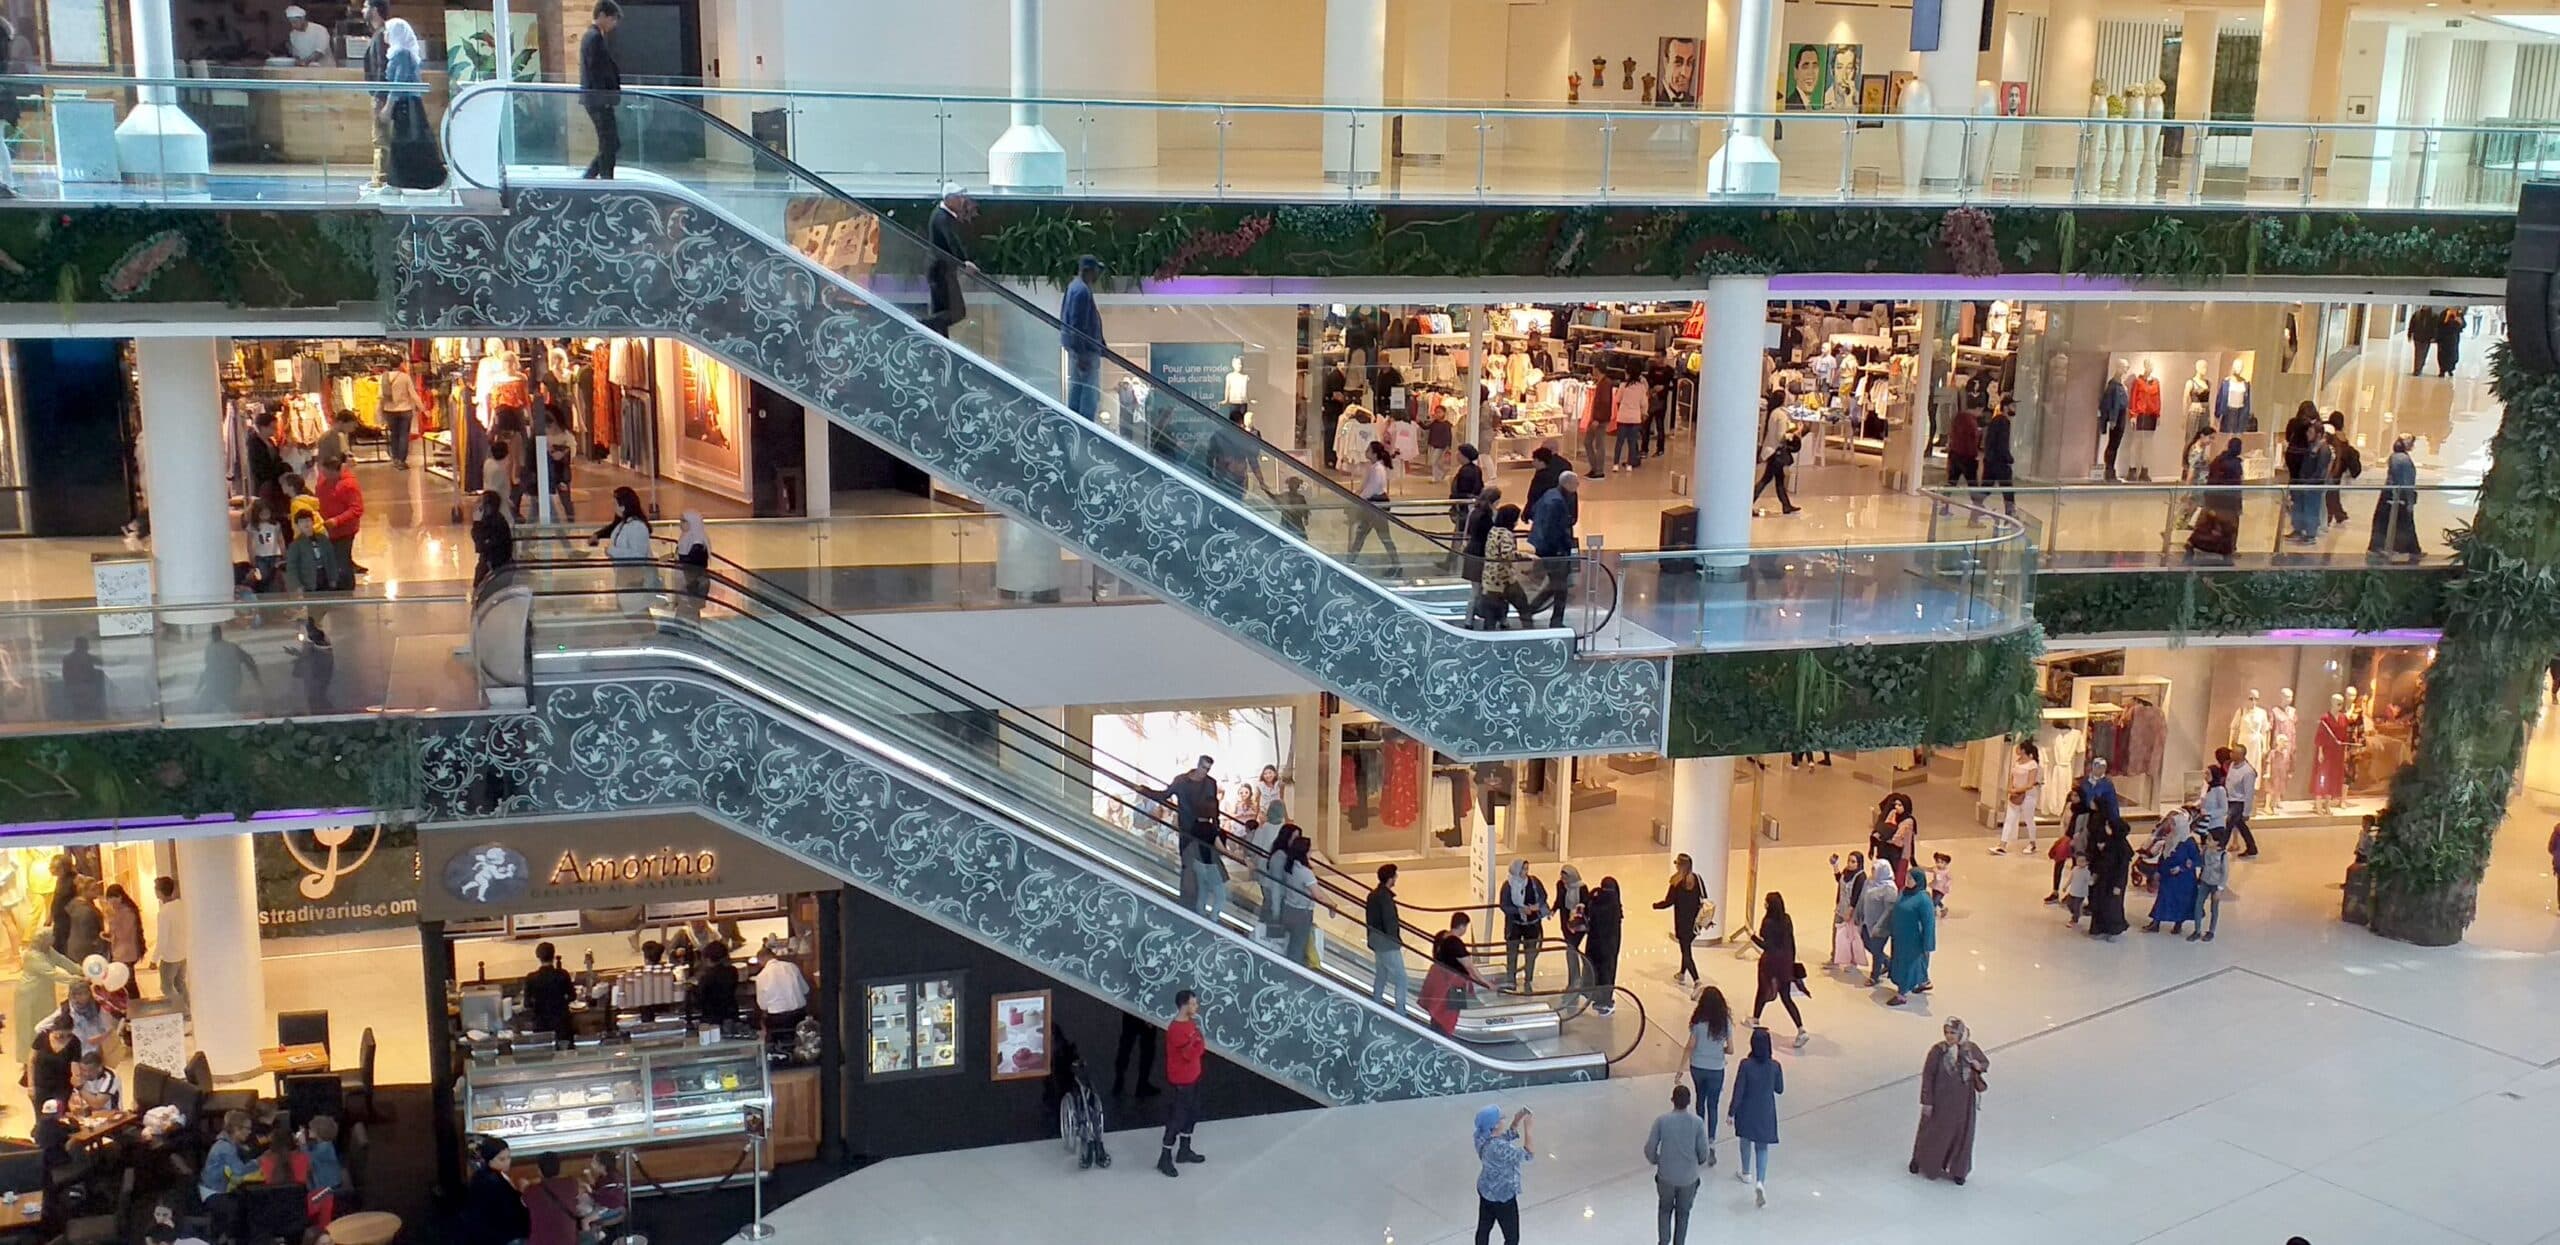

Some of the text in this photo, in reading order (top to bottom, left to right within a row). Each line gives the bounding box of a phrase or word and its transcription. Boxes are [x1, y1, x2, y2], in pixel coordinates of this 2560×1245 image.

[1162, 364, 1182, 373] Pour
[1185, 365, 1200, 373] une
[1167, 374, 1221, 384] plus durable
[550, 847, 714, 885] Amorino
[259, 899, 417, 925] stradivarius.com
